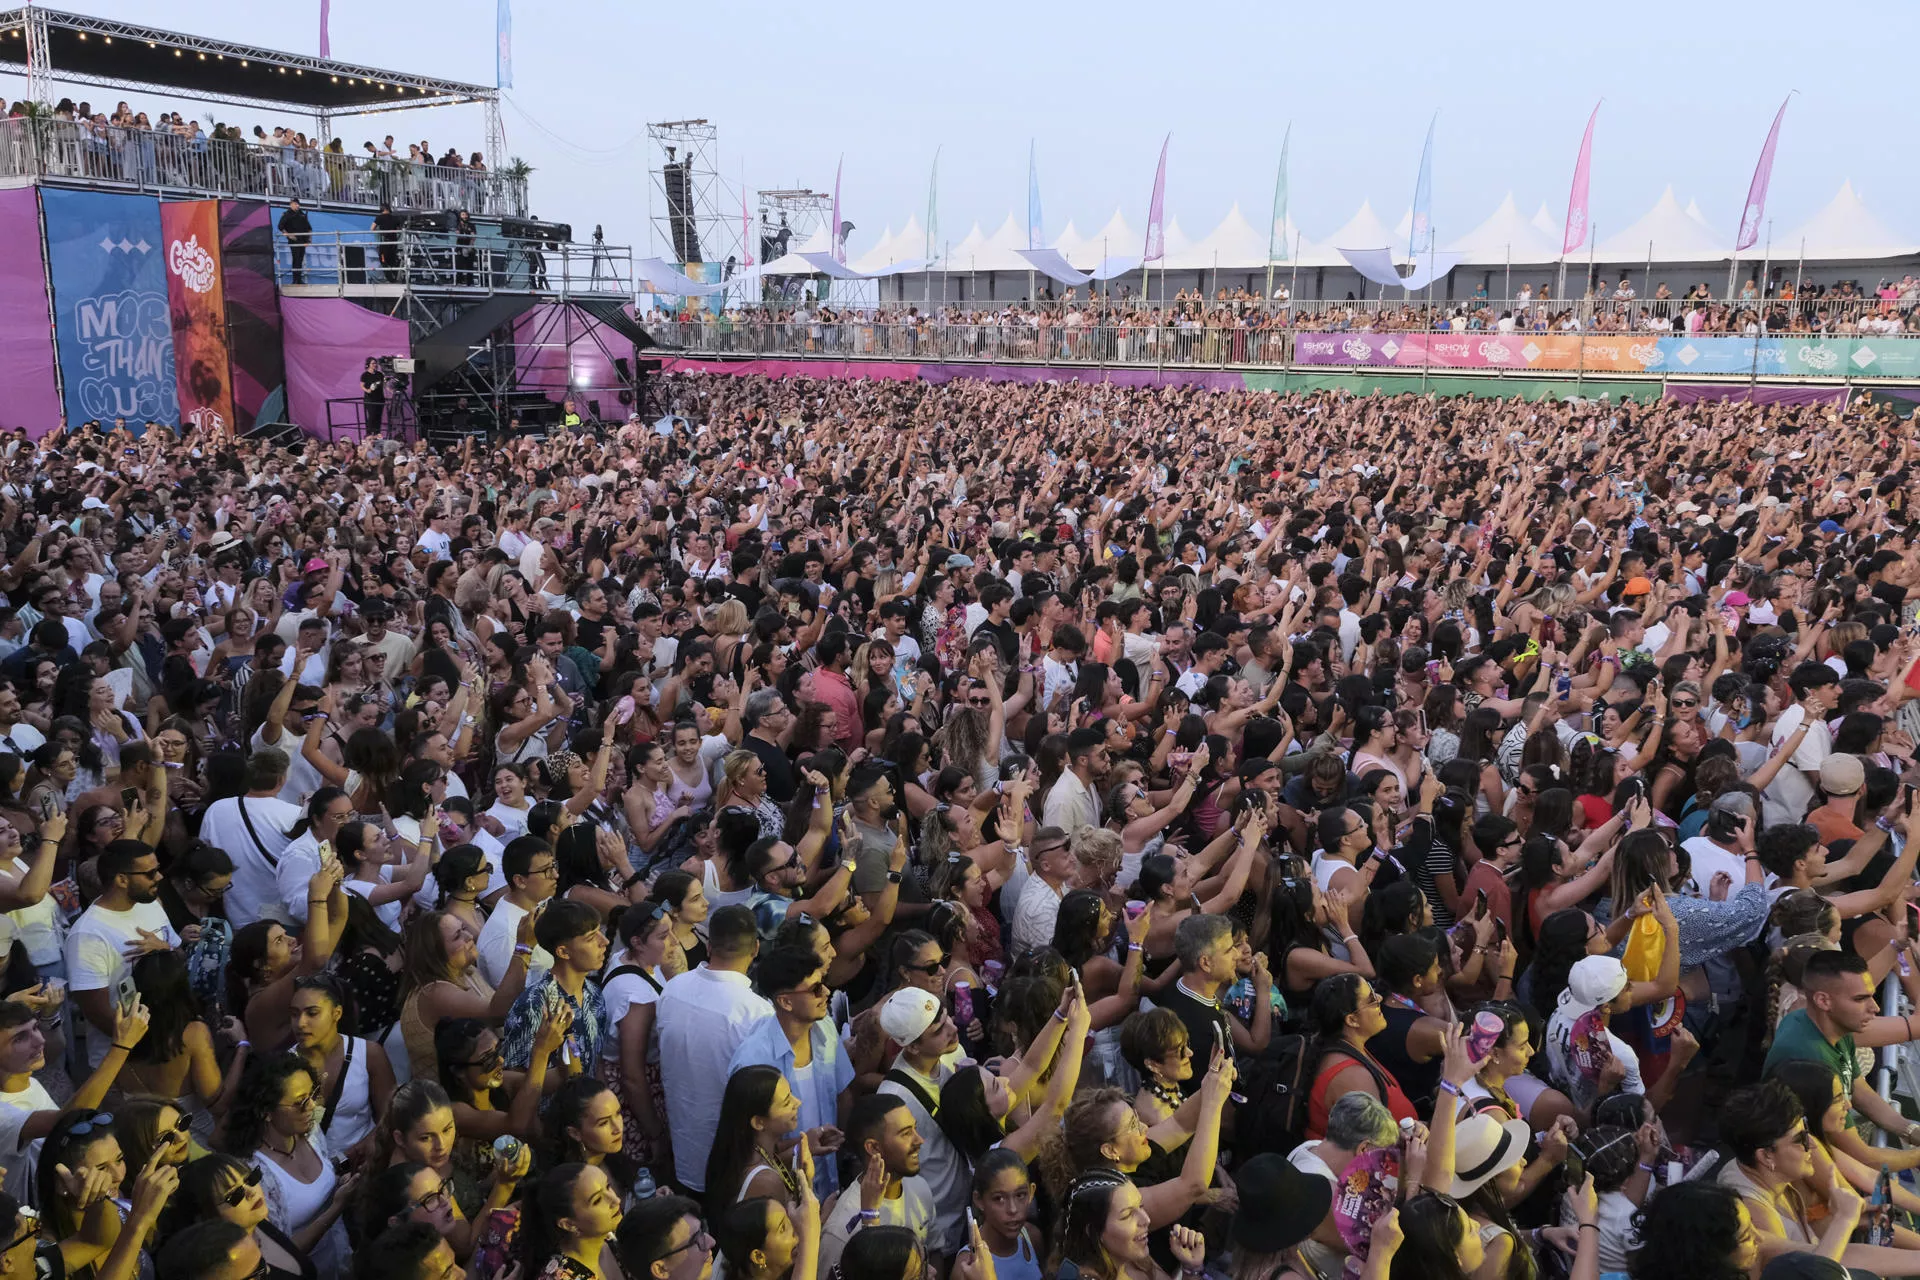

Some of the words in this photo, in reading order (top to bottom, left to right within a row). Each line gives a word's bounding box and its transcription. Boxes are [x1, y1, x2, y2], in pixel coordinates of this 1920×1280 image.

[81, 296, 173, 340] MOR
[95, 336, 173, 382] THAN
[85, 380, 180, 417] MUSI
